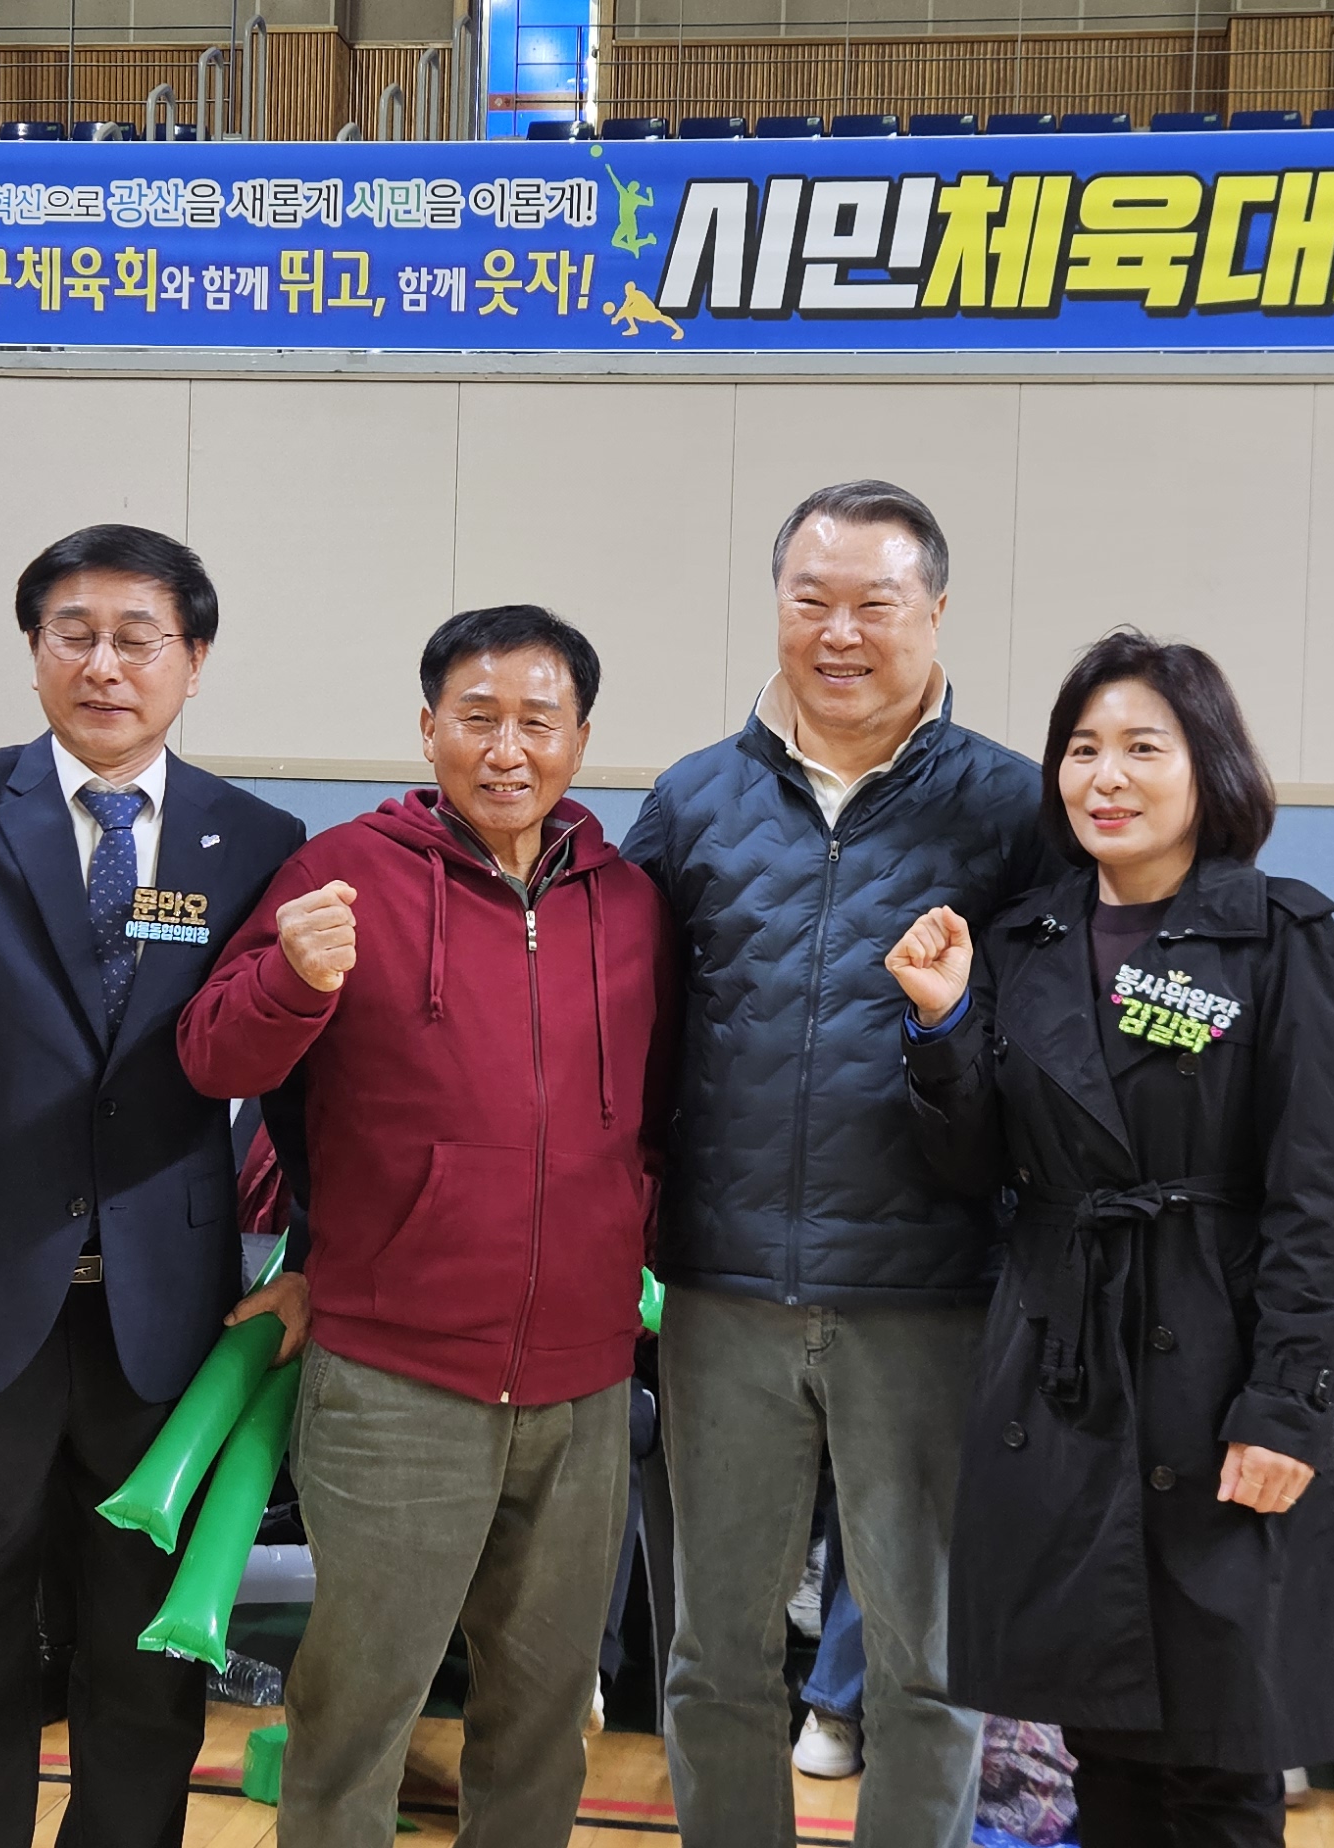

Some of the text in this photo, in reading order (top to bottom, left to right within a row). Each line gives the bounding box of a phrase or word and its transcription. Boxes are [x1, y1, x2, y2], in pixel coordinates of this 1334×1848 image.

[112, 184, 219, 222] 광산을
[231, 183, 339, 221] 새롭게
[353, 183, 459, 222] 시민을
[473, 182, 593, 222] 이롭게!
[201, 267, 267, 311] 함께
[279, 249, 386, 317] 뛰고,
[398, 267, 465, 312] 함께
[475, 249, 594, 316] 웃자!
[1115, 964, 1241, 1029] 봉사위원장
[1119, 997, 1212, 1053] 김길화
